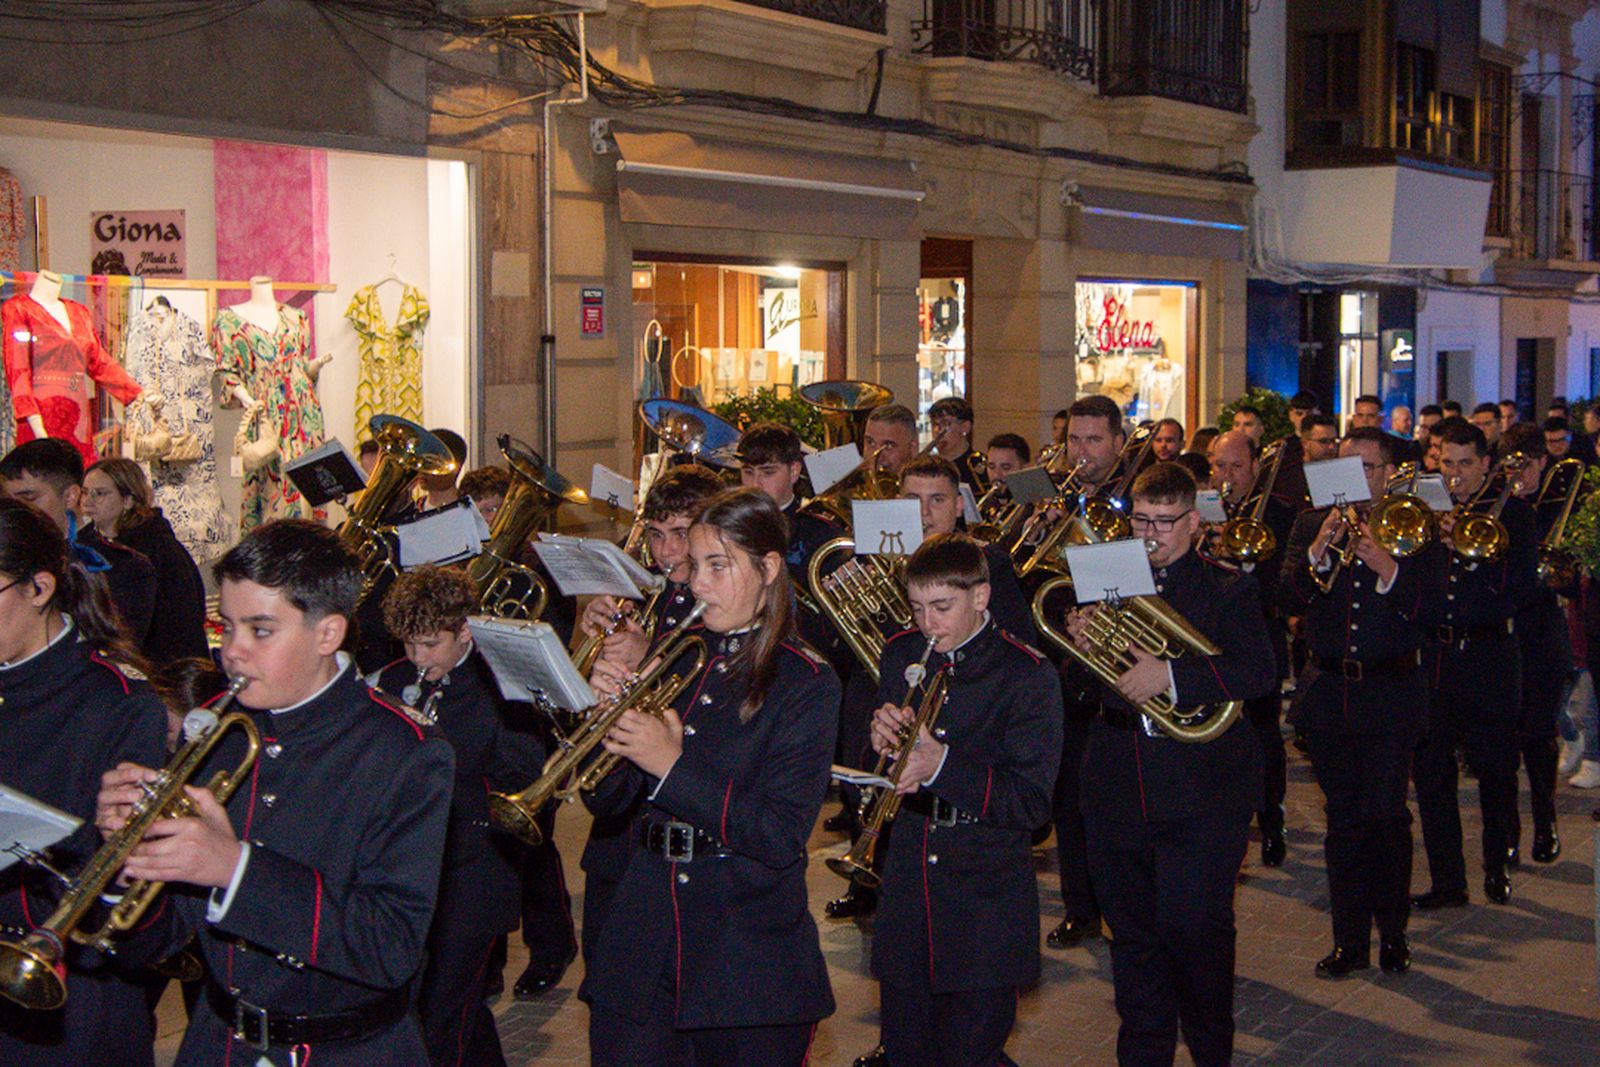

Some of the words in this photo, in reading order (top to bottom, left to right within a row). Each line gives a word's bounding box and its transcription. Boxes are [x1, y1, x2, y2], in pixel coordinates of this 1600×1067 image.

[95, 214, 182, 242] Giona
[169, 252, 177, 264] &
[1098, 295, 1153, 352] Elena
